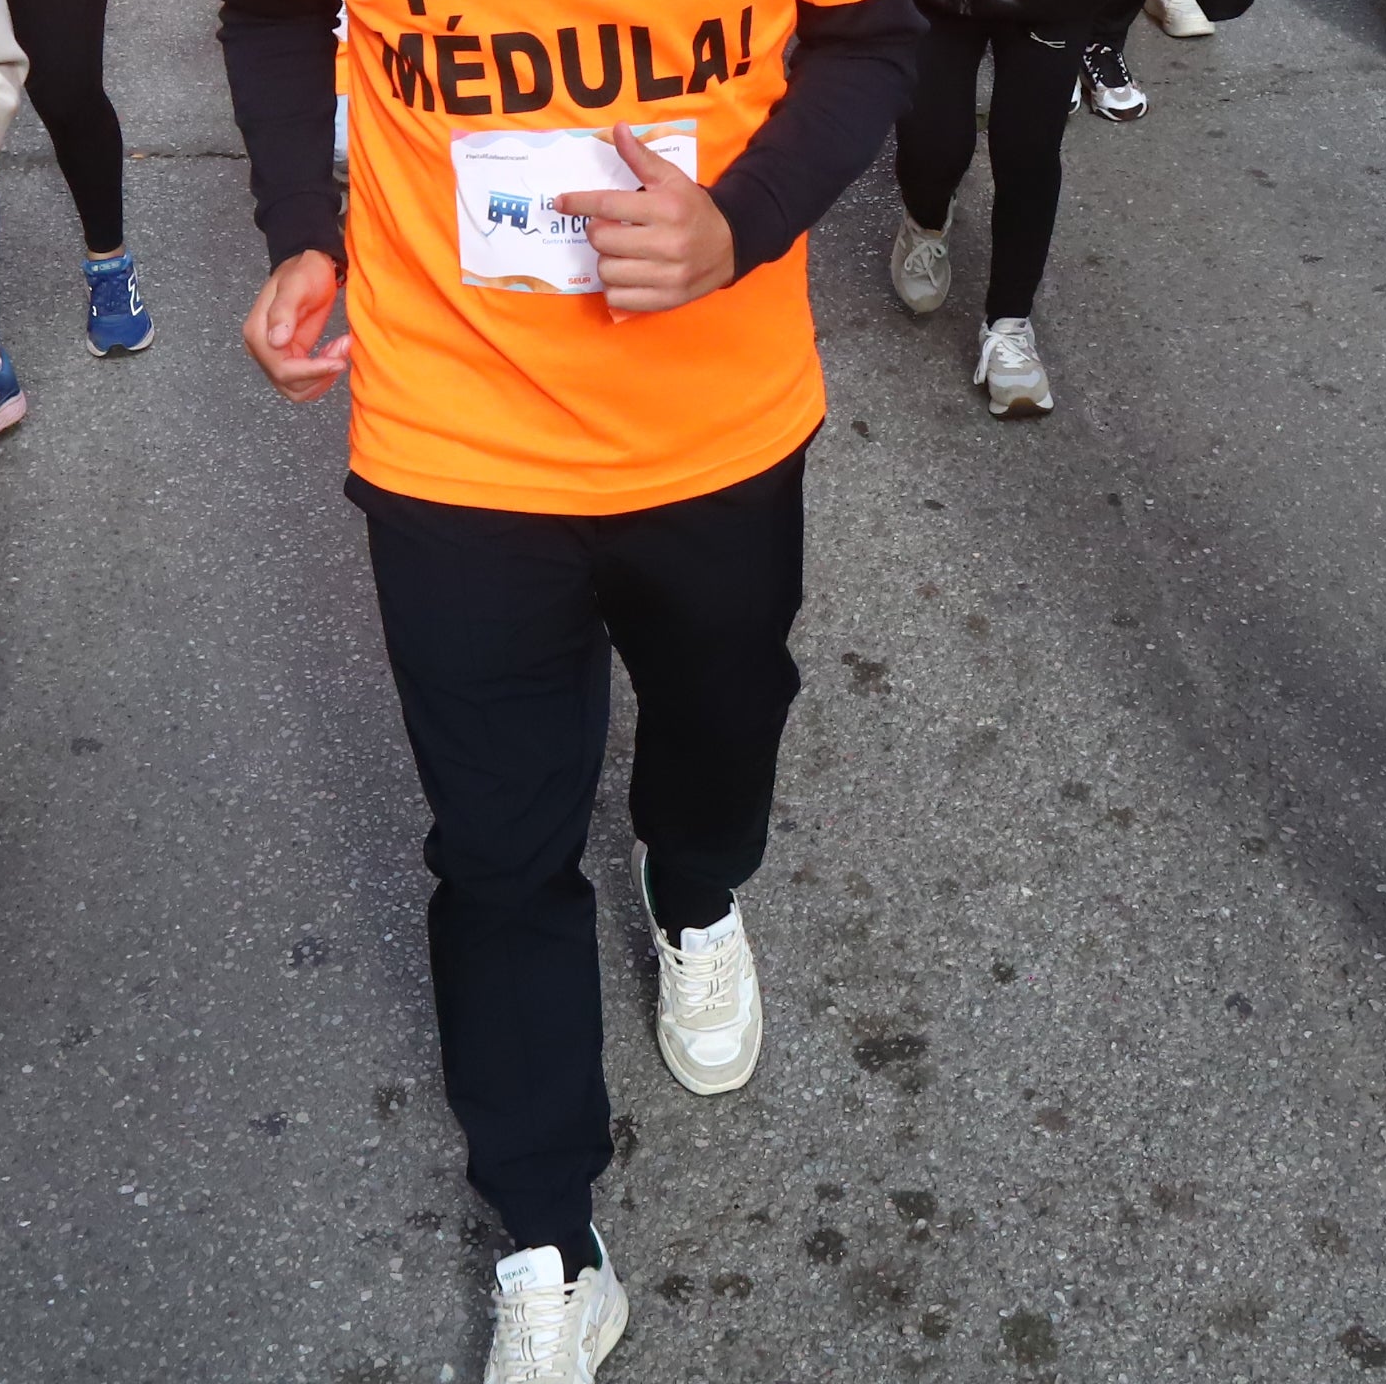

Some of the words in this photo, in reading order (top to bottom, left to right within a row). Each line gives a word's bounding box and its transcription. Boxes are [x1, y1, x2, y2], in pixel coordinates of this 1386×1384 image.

[381, 5, 753, 114] MÉDULA!
[550, 217, 565, 234] al
[568, 276, 591, 285] SEUR
[500, 1266, 529, 1282] PREMIATA
